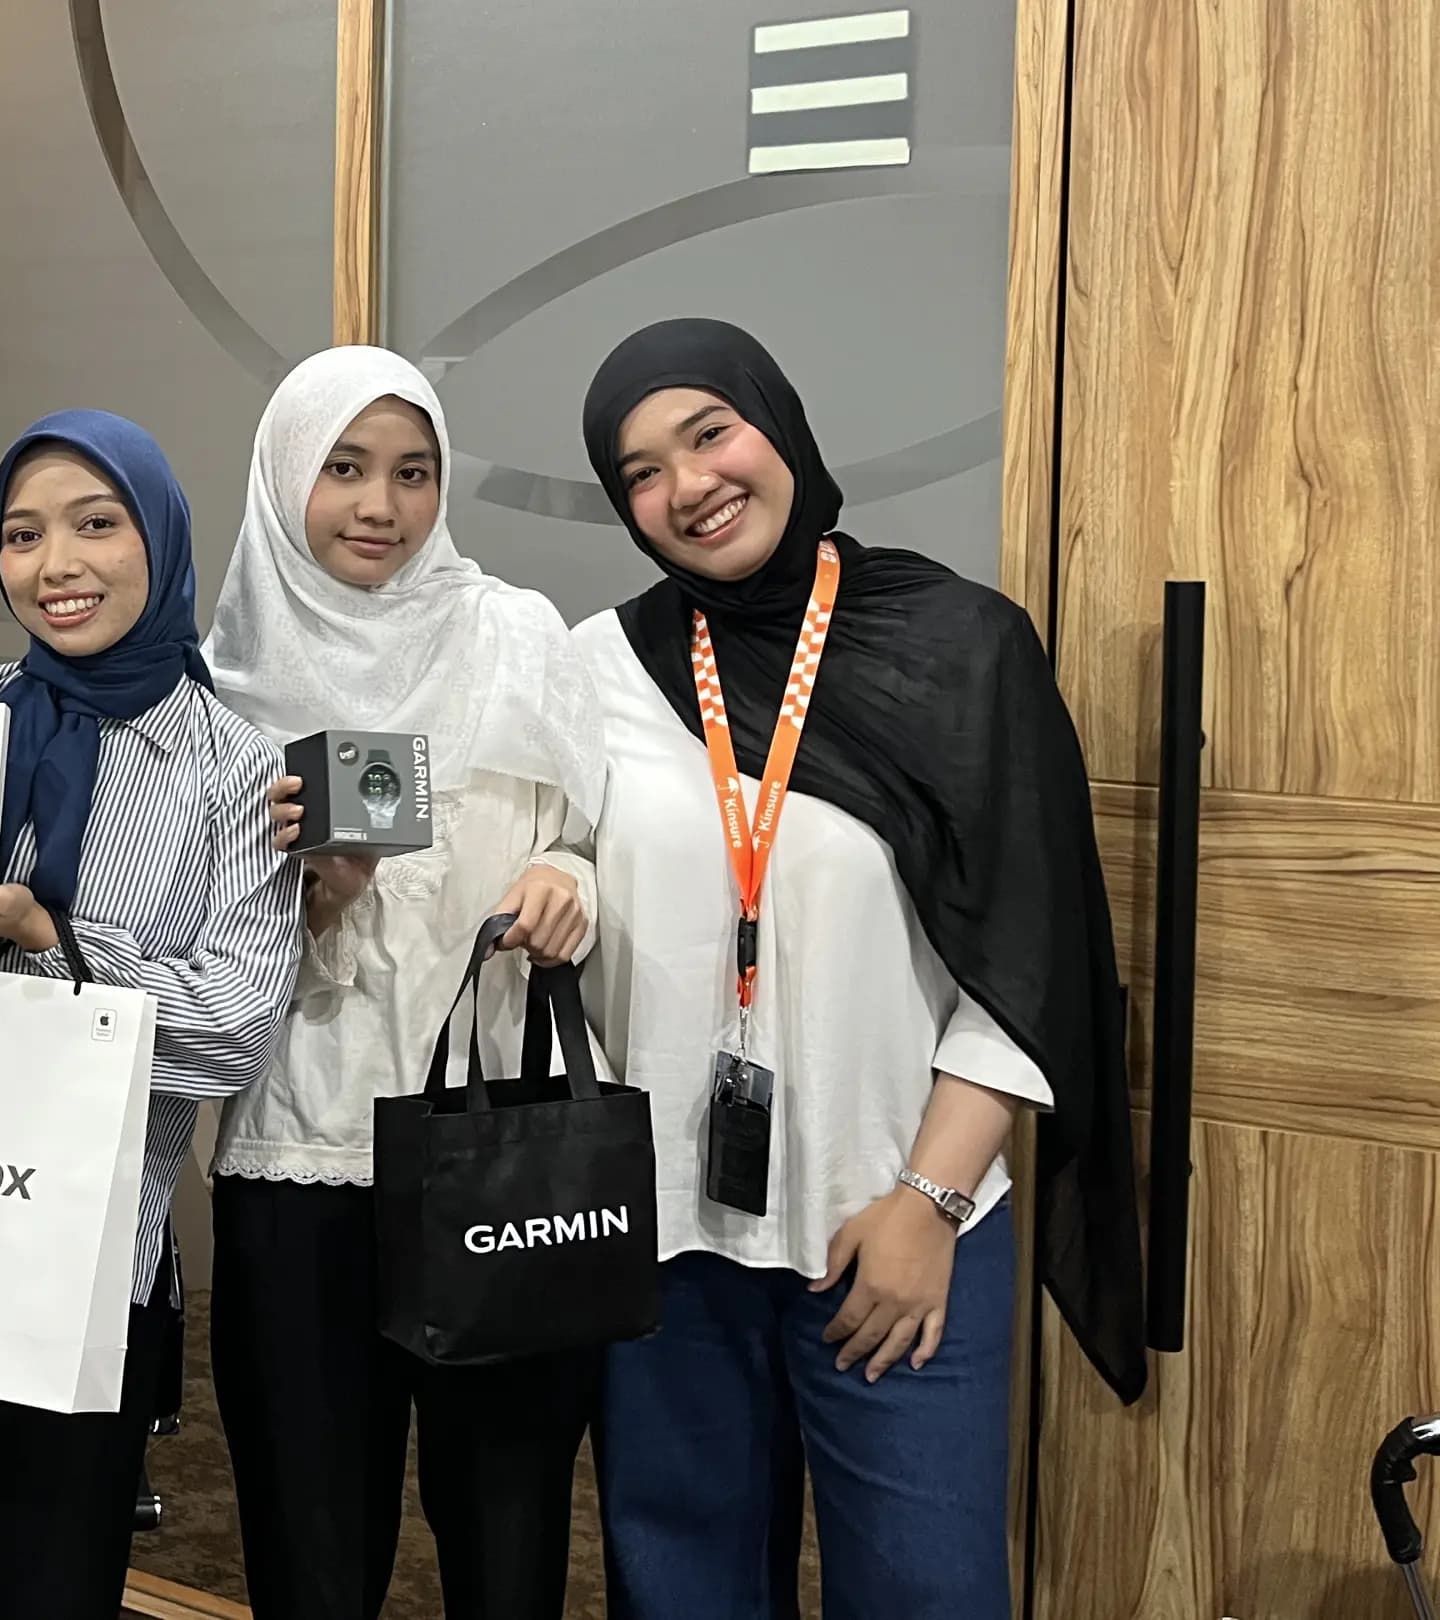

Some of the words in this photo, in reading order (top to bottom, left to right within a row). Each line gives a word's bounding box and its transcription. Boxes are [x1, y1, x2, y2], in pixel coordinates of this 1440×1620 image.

[412, 736, 429, 819] GARMIN
[724, 798, 743, 848] Kinsure
[758, 780, 782, 832] Kinsure
[464, 1205, 629, 1254] GARMIN
